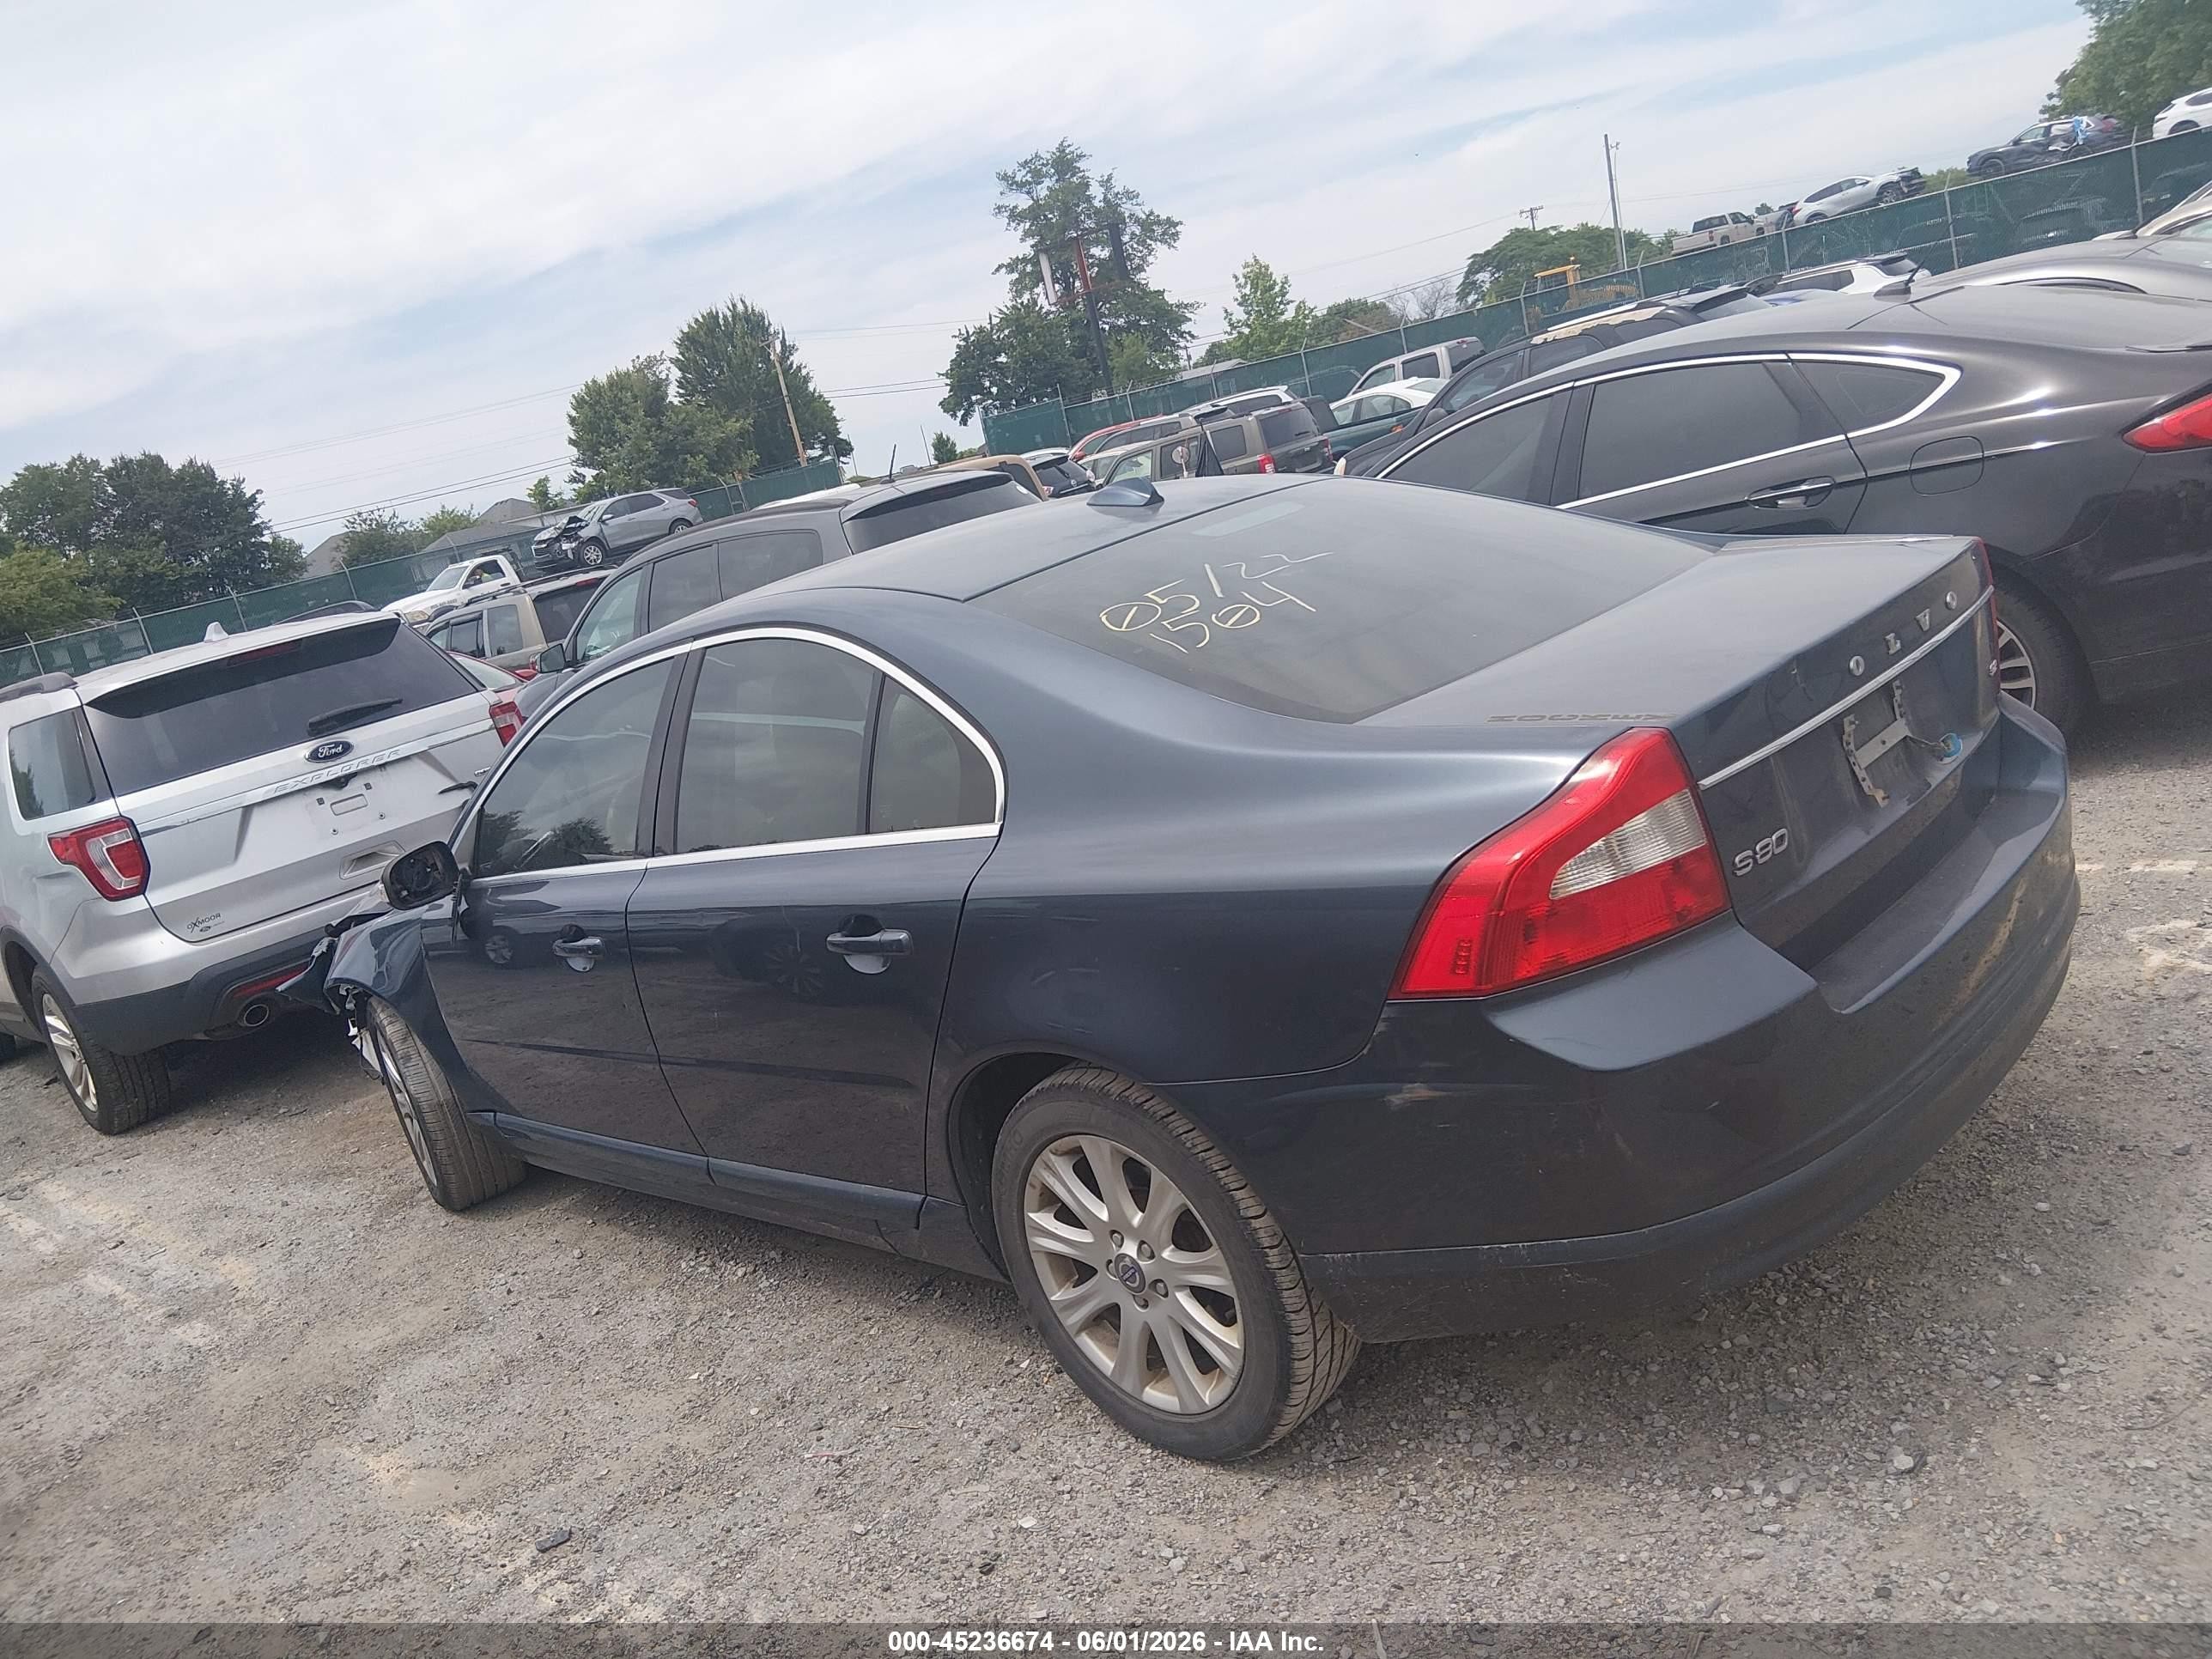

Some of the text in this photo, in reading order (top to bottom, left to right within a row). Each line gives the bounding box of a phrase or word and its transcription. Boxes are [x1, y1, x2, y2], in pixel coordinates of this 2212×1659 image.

[274, 749, 401, 794] EXPLORER
[318, 744, 344, 758] Ford
[1734, 828, 1789, 877] S80
